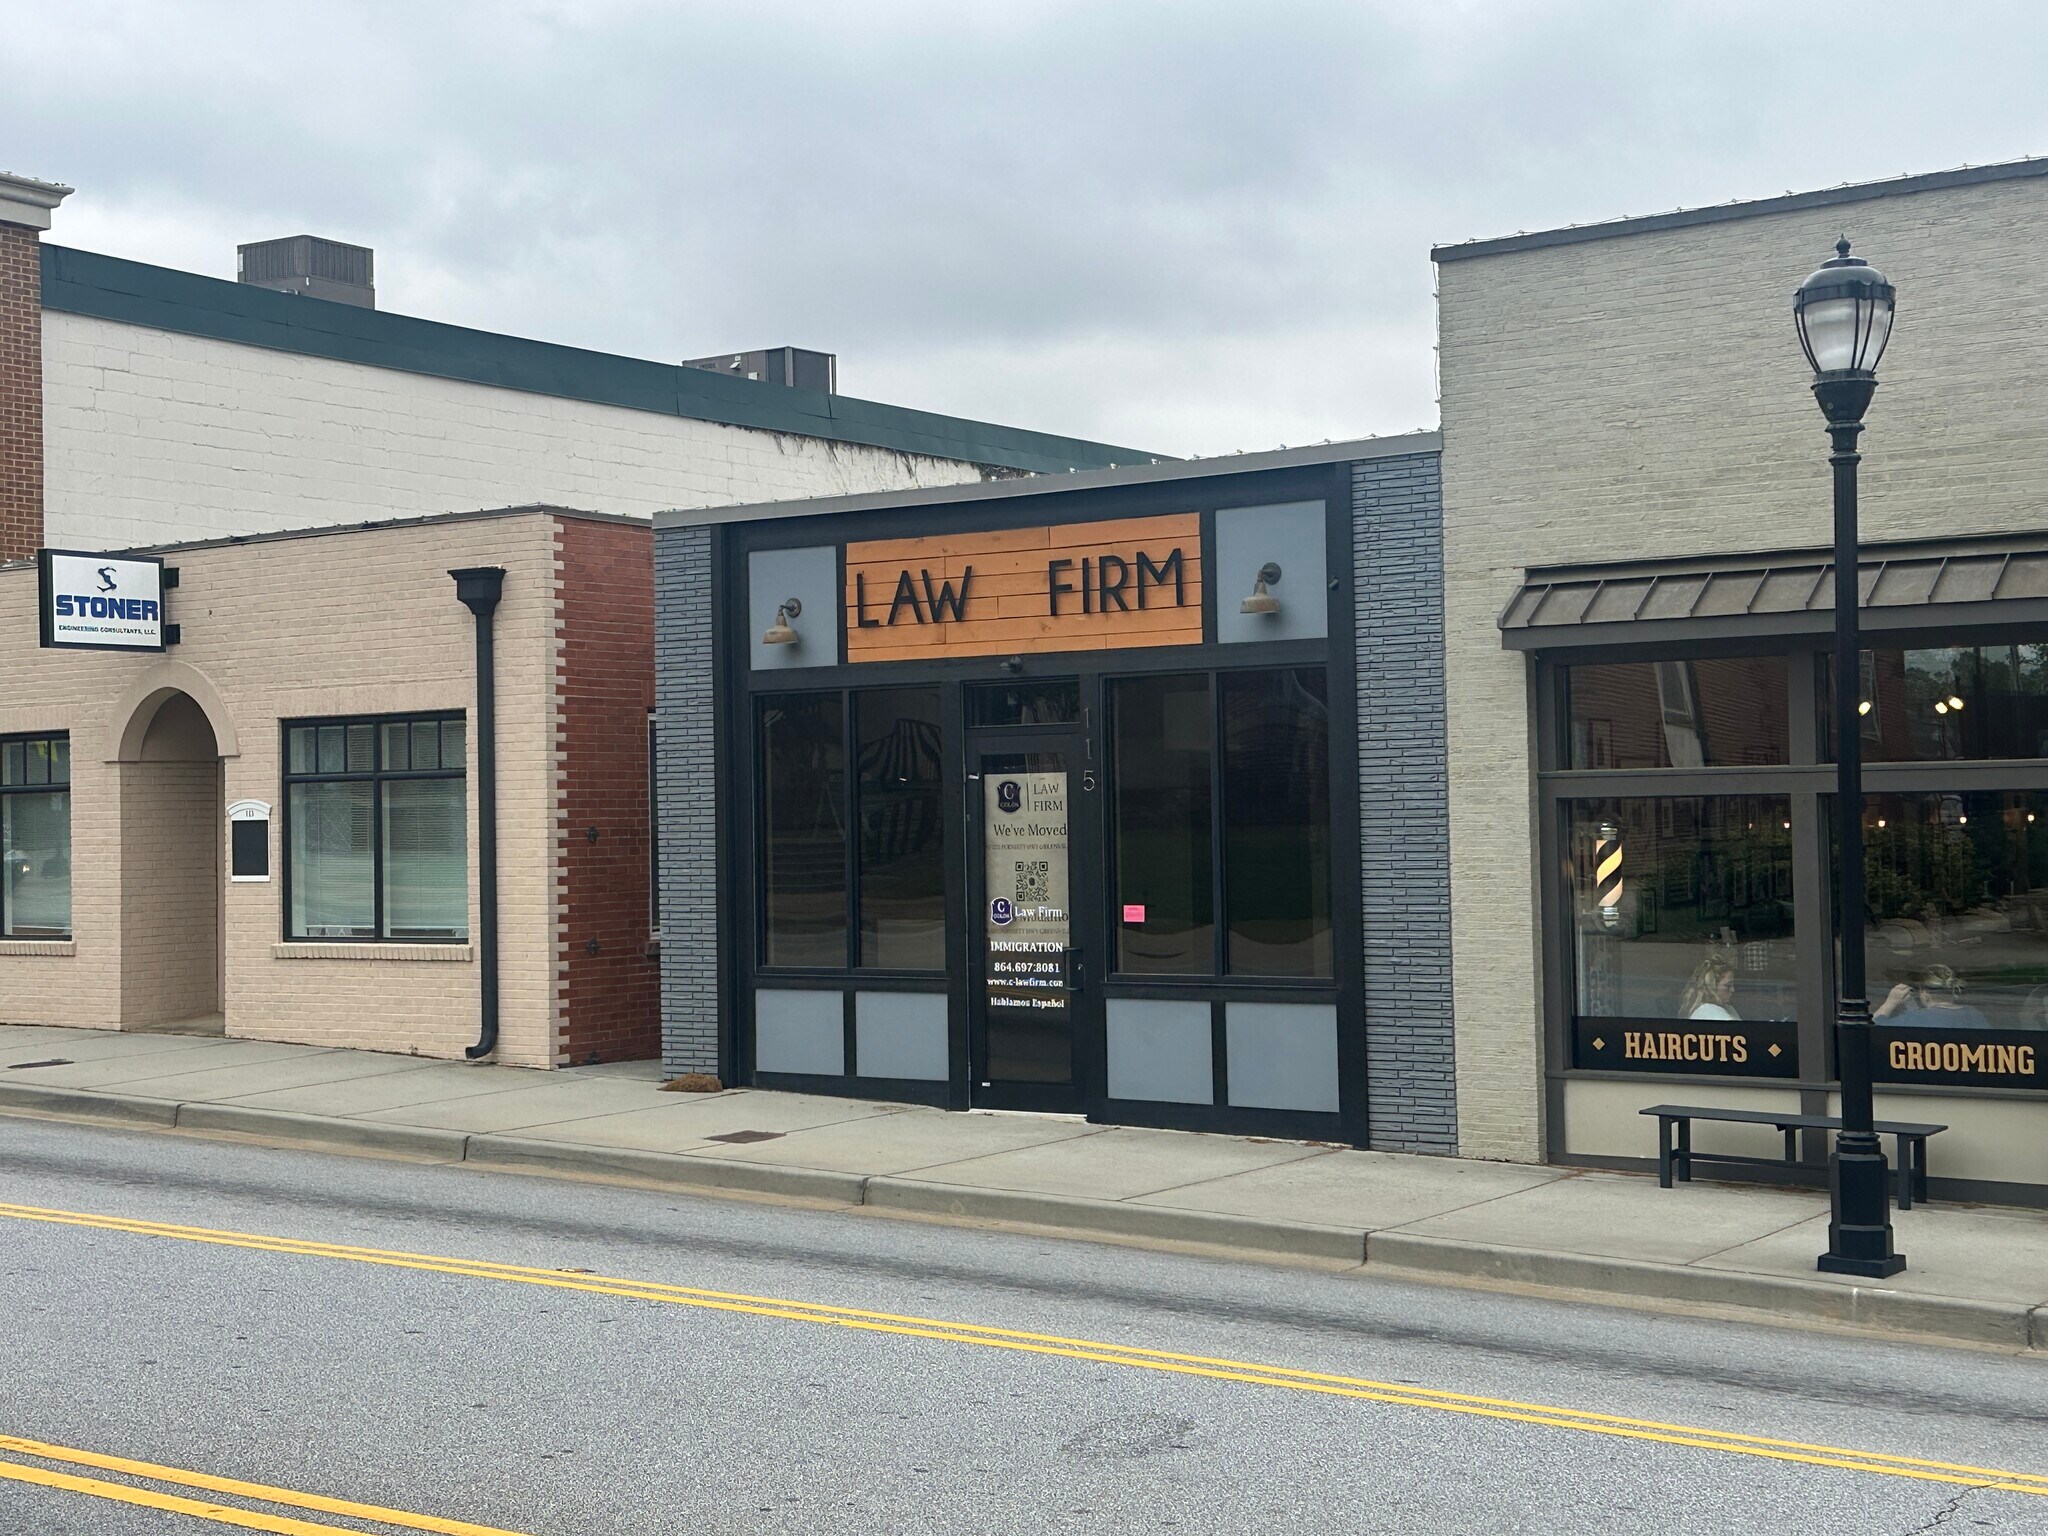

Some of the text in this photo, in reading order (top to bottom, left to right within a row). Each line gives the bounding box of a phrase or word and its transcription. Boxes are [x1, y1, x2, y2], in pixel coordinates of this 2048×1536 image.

[856, 547, 1184, 628] LAW FIRM
[56, 594, 159, 621] STONER
[58, 624, 99, 632] ENGINEERING
[1033, 783, 1059, 795] LAW
[1034, 800, 1063, 812] FIRM
[994, 823, 1067, 837] We've Moved
[1014, 906, 1036, 917] Law
[1038, 906, 1063, 918] Firm
[990, 941, 1063, 953] IMMIGRATION
[990, 997, 1065, 1009] Hablamos Español
[1624, 1032, 1748, 1063] HAIRCUTS
[1889, 1041, 2035, 1075] GROOMING
